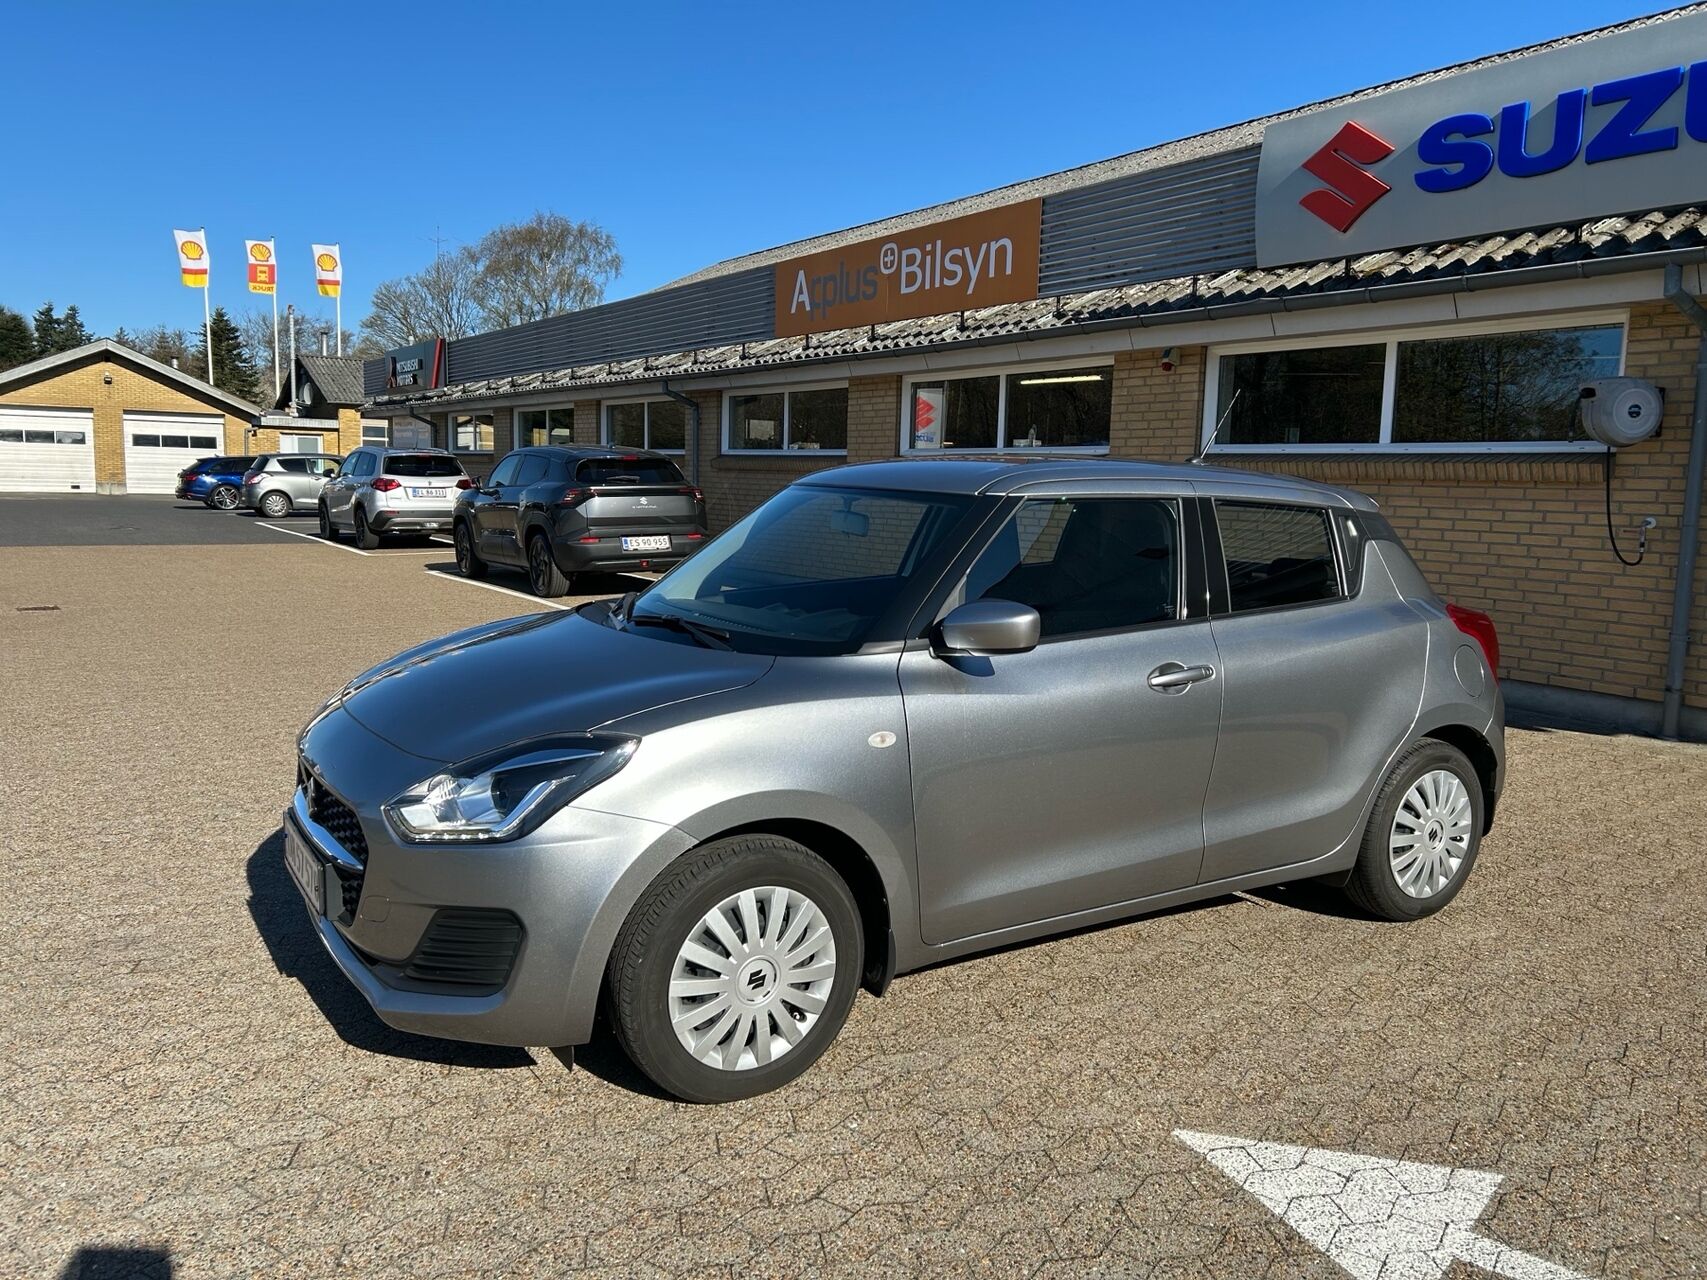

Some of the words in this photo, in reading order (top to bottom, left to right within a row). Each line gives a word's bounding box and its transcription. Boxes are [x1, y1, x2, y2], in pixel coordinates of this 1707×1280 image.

[1414, 60, 1707, 194] SUZ
[900, 236, 1013, 296] Bilsyn
[629, 538, 640, 547] ES
[641, 538, 652, 546] 90
[652, 537, 668, 546] 955
